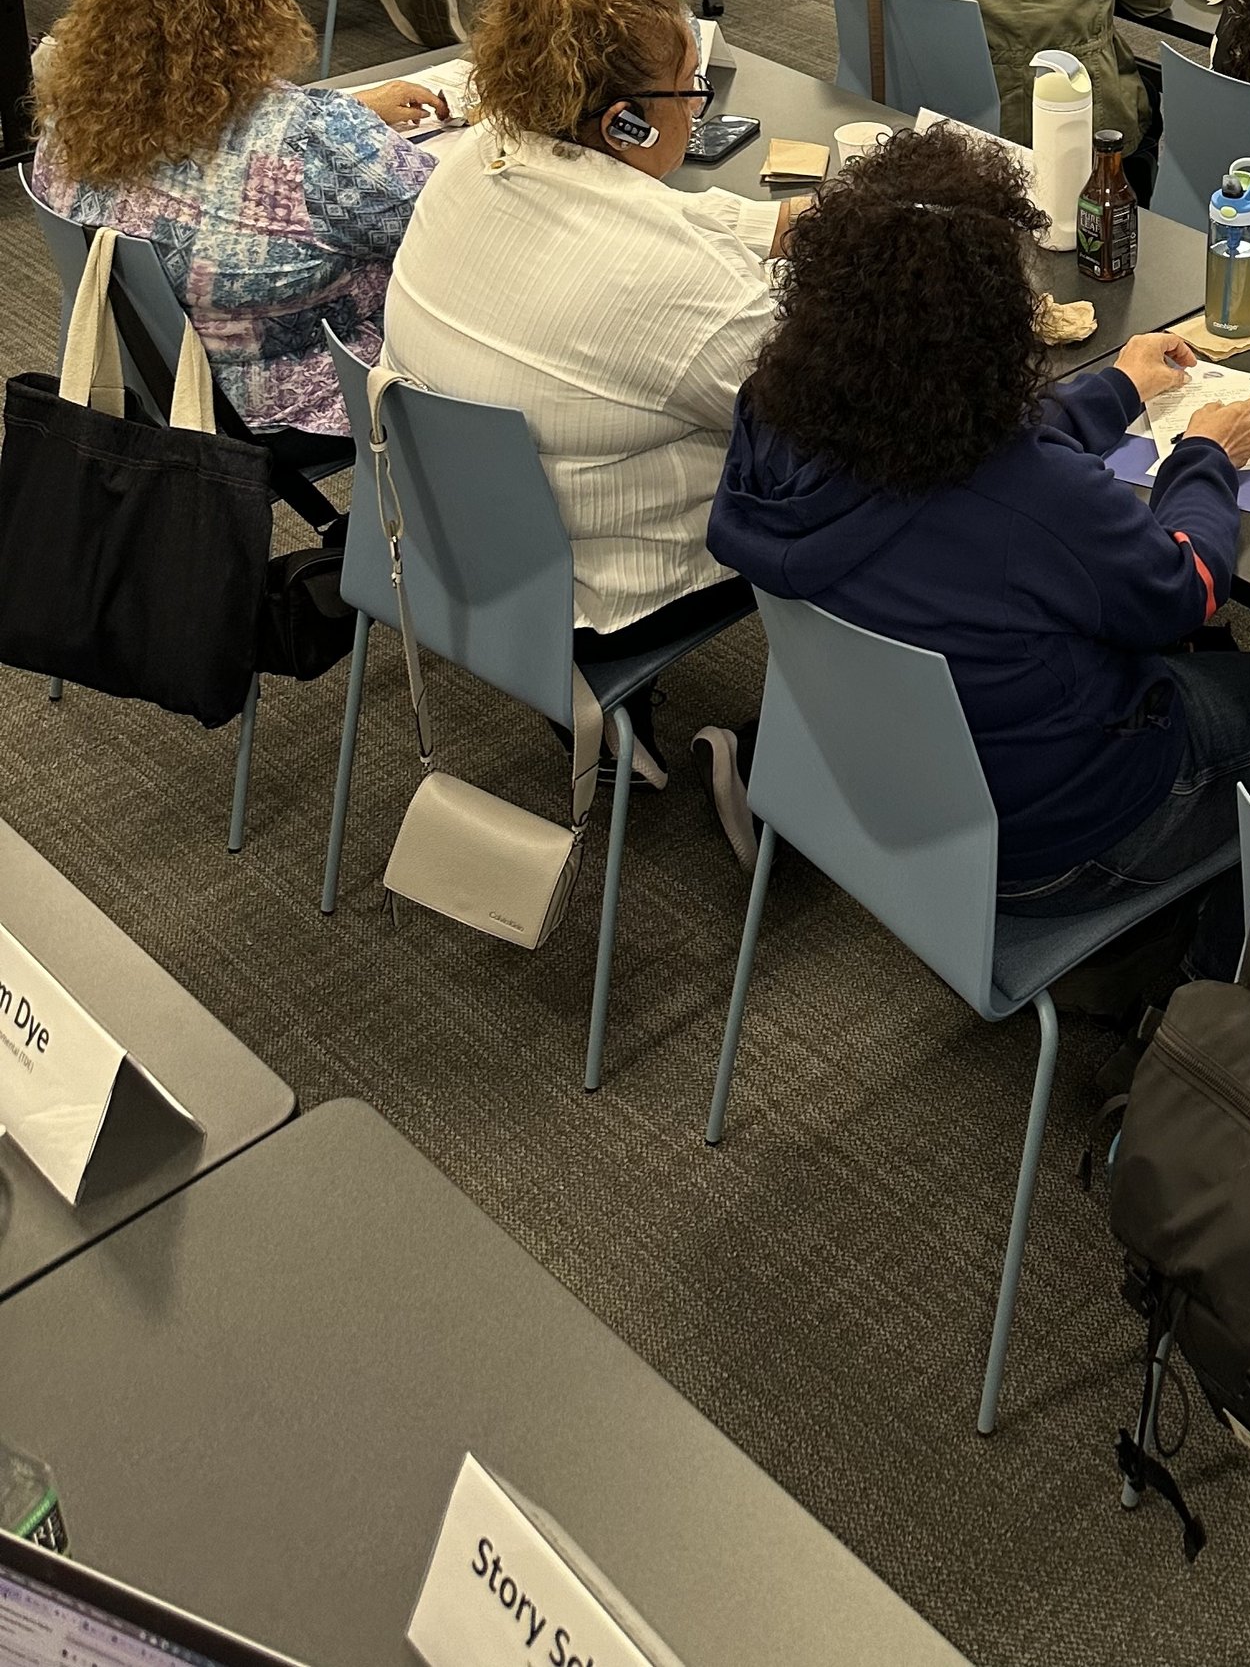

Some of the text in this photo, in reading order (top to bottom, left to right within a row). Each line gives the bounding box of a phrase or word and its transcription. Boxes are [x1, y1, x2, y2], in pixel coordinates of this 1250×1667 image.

[1080, 209, 1101, 224] PURE
[14, 996, 50, 1053] Dye
[472, 1537, 546, 1648] Story
